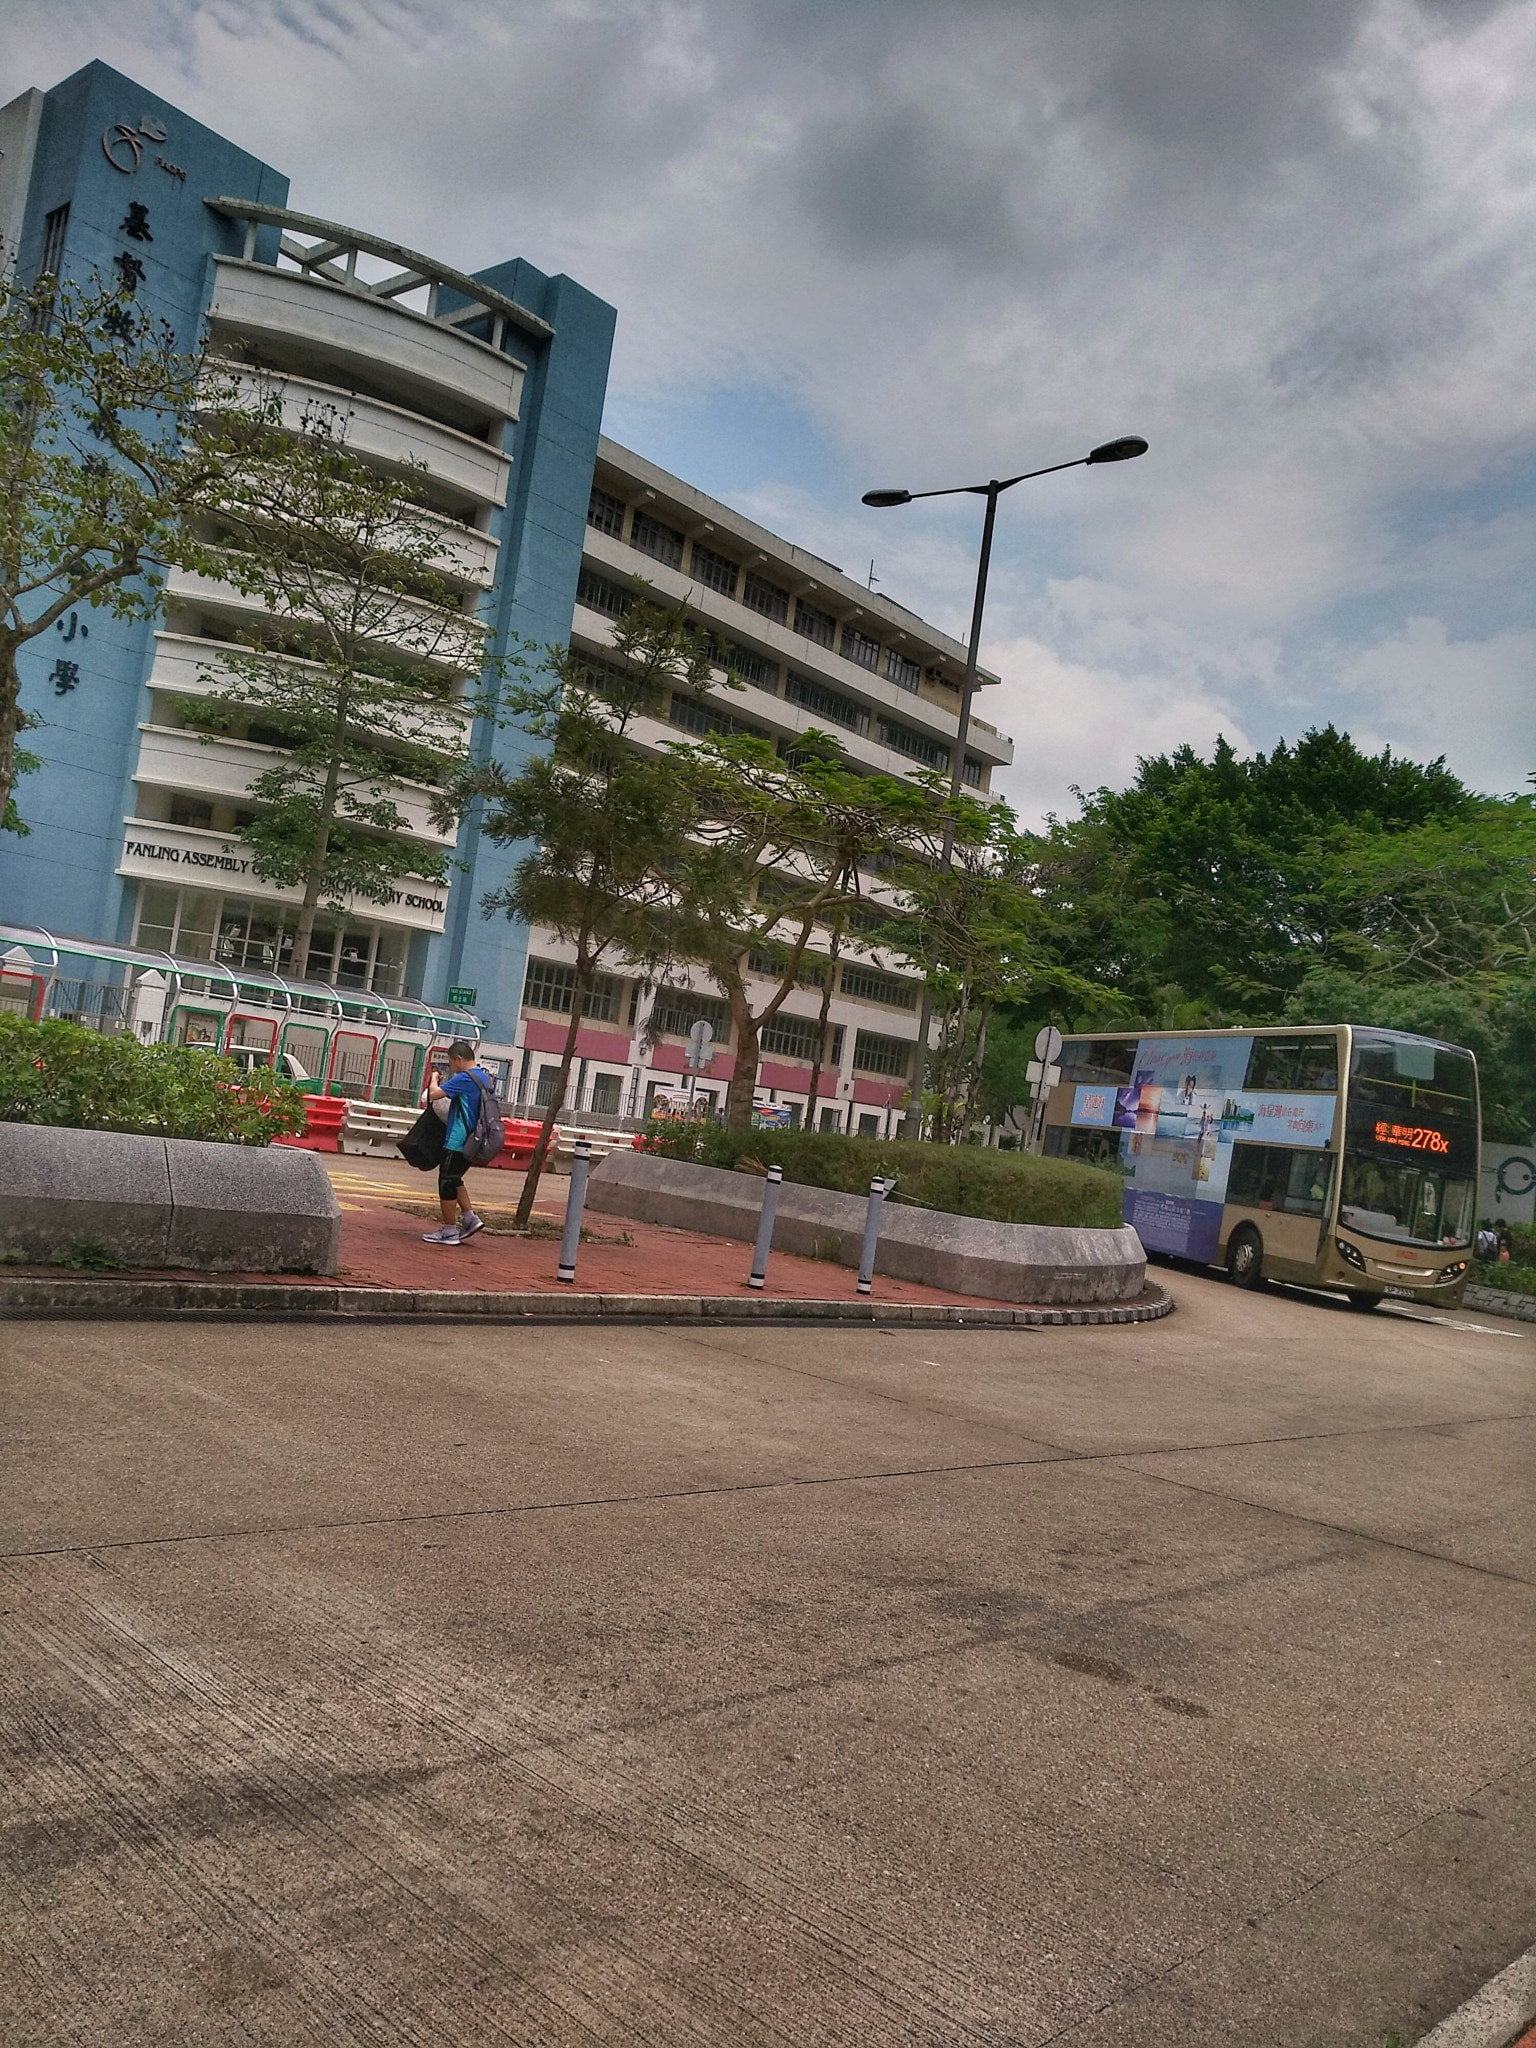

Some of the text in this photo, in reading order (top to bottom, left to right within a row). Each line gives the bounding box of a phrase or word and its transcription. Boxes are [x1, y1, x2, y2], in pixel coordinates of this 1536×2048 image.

[126, 841, 180, 862] FANLING
[182, 851, 250, 873] ASSEMBLY
[405, 893, 445, 913] SCHOOL
